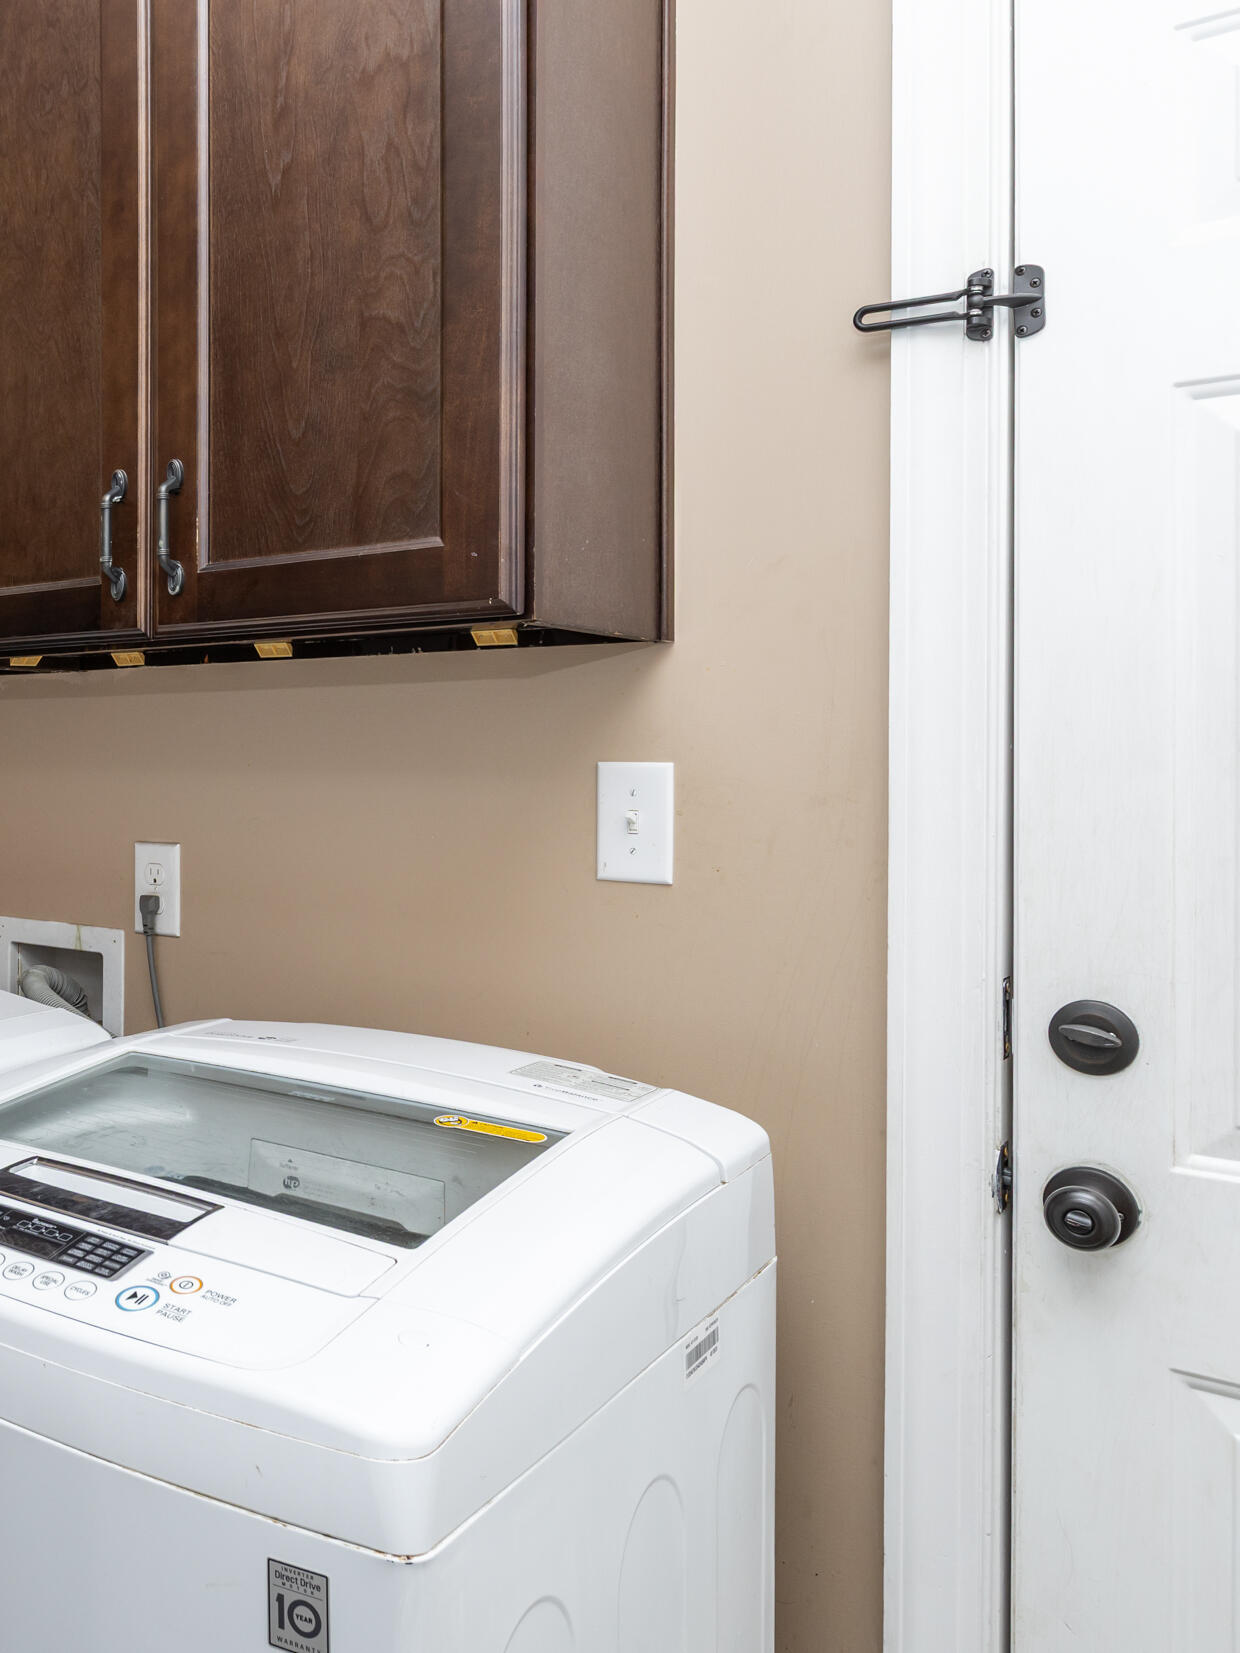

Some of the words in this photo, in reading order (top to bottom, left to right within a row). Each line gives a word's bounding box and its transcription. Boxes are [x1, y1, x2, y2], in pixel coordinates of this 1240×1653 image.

[205, 1289, 237, 1303] POWER
[156, 1309, 186, 1322] PAUSE
[163, 1303, 192, 1316] START
[281, 1566, 314, 1580] INVERTER
[274, 1570, 299, 1585] Direct
[300, 1578, 321, 1592] Drive
[275, 1593, 322, 1639] 10
[295, 1613, 313, 1624] YEAR
